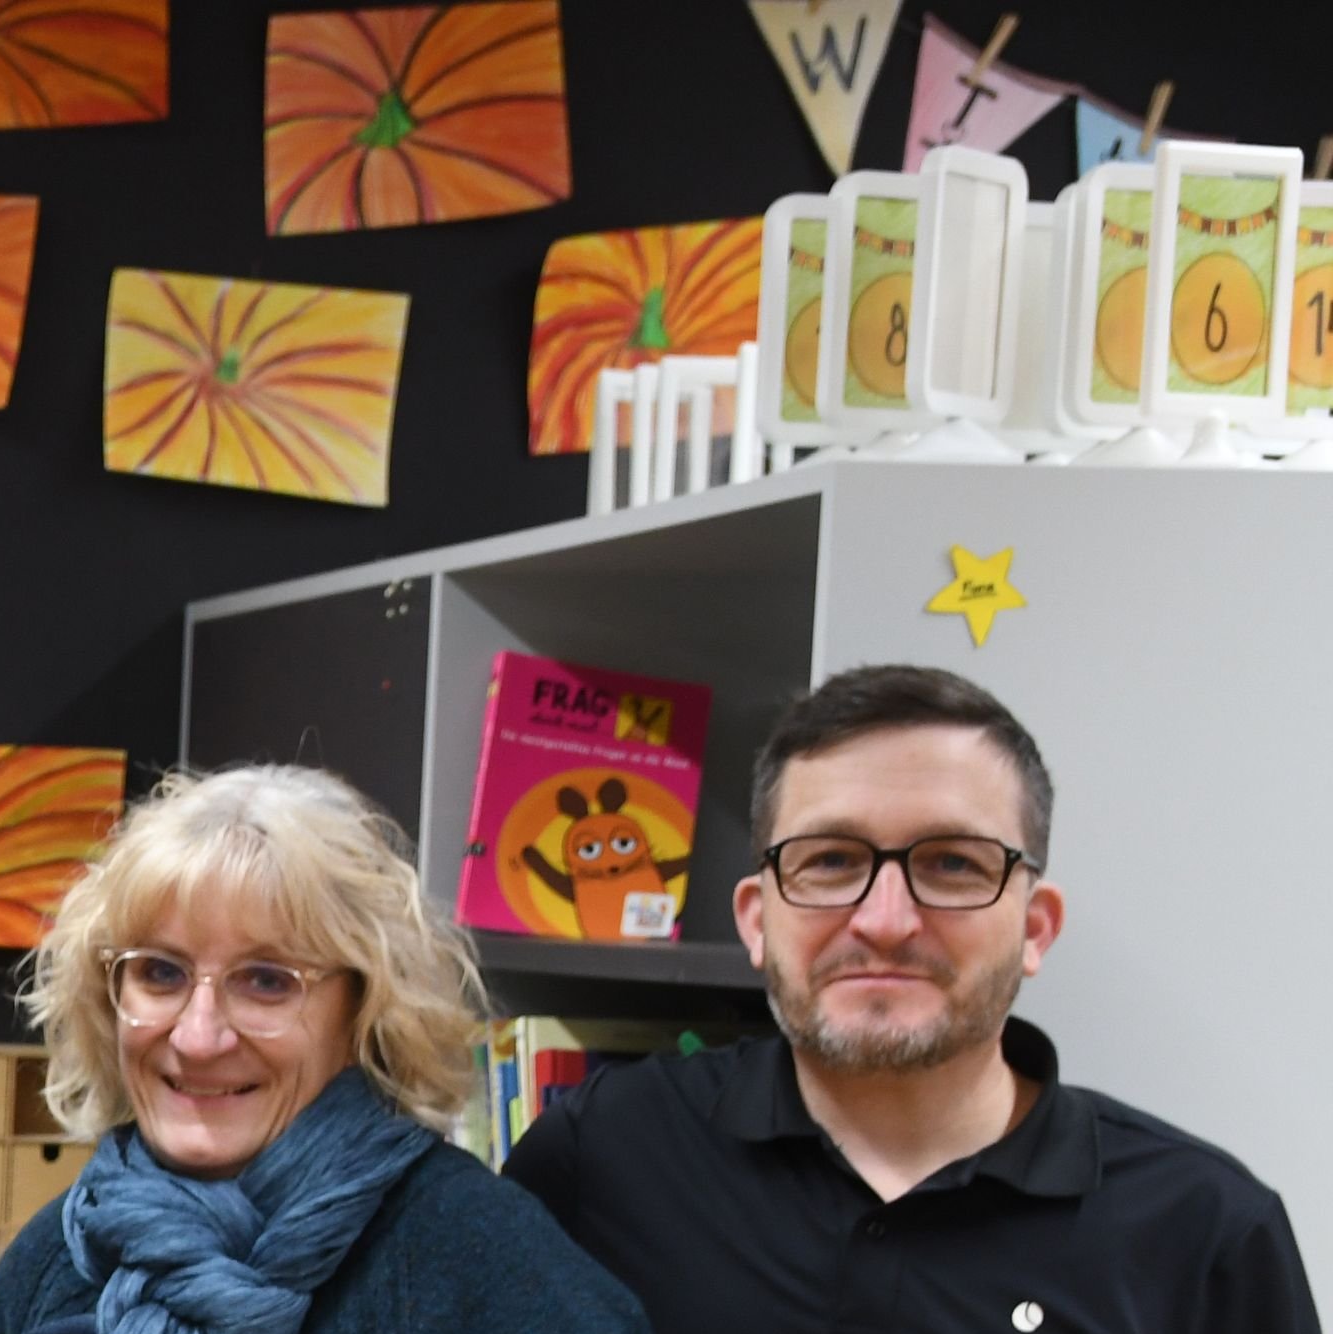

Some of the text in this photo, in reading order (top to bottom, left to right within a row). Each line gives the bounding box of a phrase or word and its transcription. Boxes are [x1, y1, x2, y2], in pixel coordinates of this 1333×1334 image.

[790, 14, 868, 94] W
[885, 302, 908, 368] 8
[1204, 282, 1228, 353] 6
[1308, 290, 1333, 358] 1
[532, 678, 614, 717] FRAG
